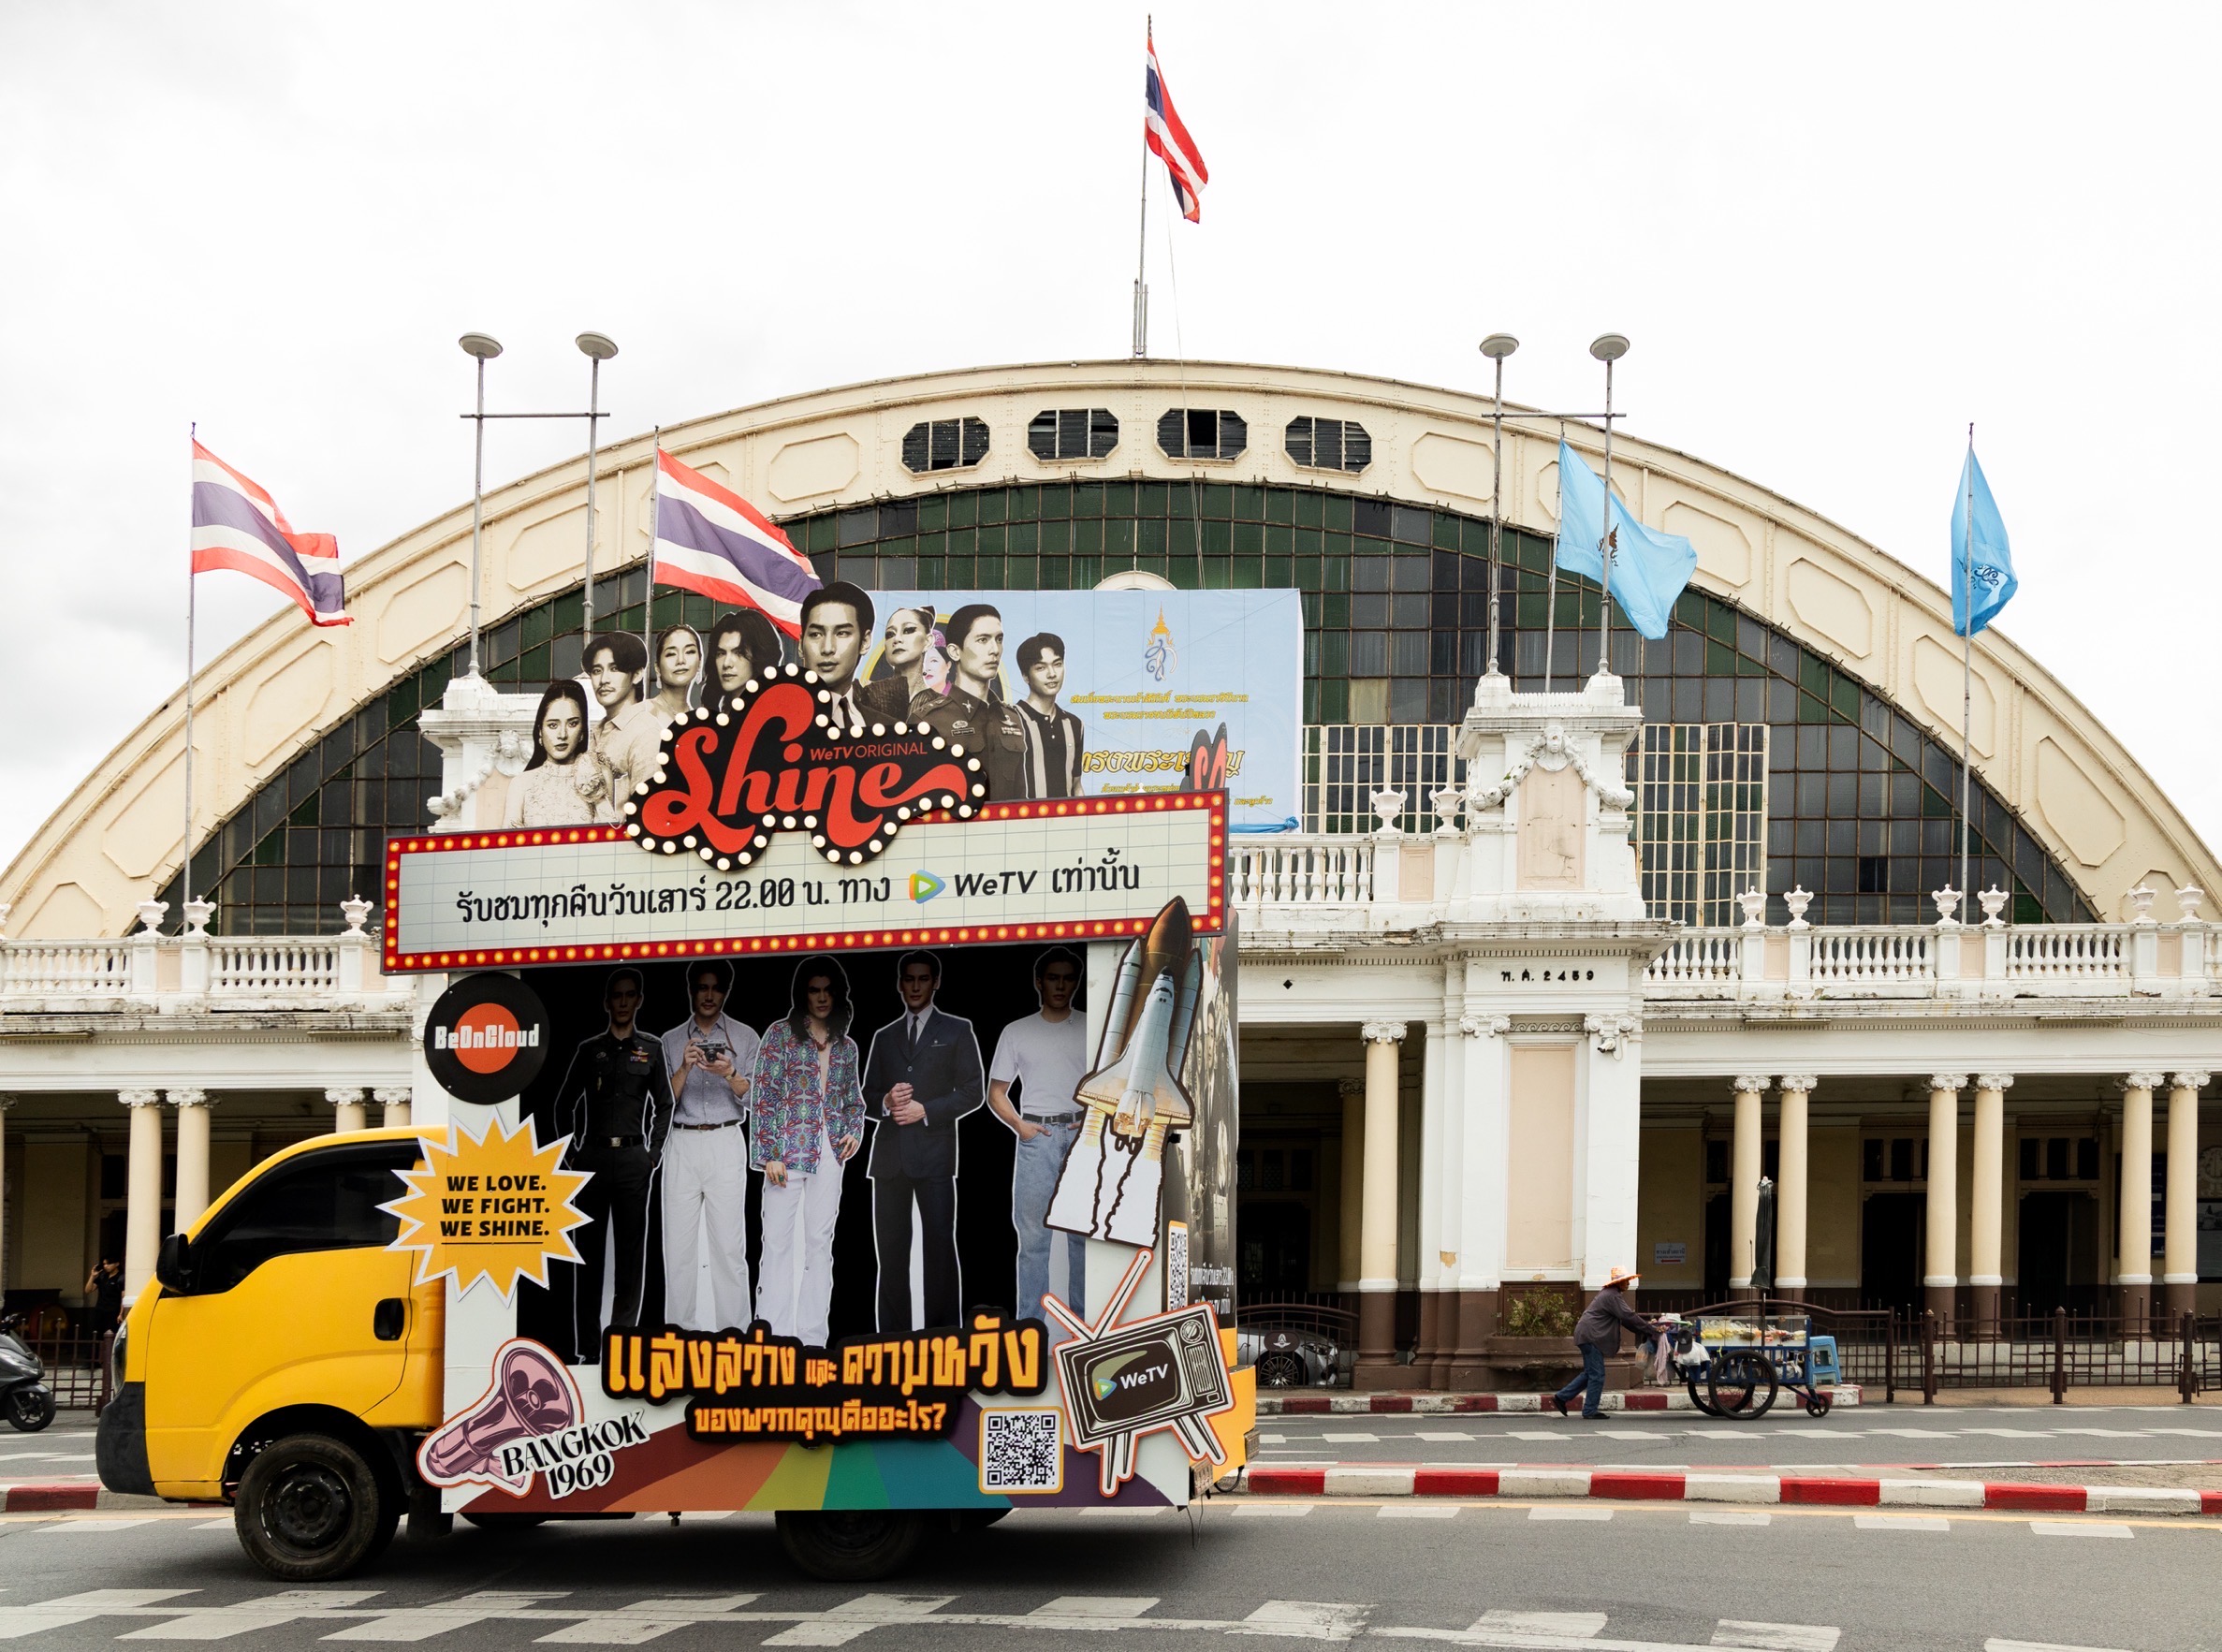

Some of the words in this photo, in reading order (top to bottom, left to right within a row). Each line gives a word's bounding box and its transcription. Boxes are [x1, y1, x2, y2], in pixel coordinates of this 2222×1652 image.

[810, 746, 854, 761] WeTV
[855, 742, 928, 758] ORIGINAL
[642, 683, 967, 854] Shine
[456, 875, 706, 928] รับชมทุกคืนวันเสาร์
[715, 879, 795, 914] 22.00
[802, 882, 829, 905] น.
[839, 875, 891, 903] ทาง
[955, 870, 1038, 897] WeTV
[1052, 848, 1139, 894] เท่านั้น
[1543, 970, 1594, 982] 2459
[434, 1023, 539, 1049] BeOnCloud
[446, 1176, 479, 1191] WE
[486, 1176, 547, 1191] LOVE.
[442, 1198, 474, 1214] WE
[480, 1197, 550, 1214] FIGHT.
[441, 1221, 473, 1236] WE
[478, 1220, 549, 1236] SHINE.
[609, 1329, 796, 1397] แสงสว่าง
[805, 1359, 837, 1387] และ
[842, 1314, 1039, 1396] ความหวัง
[1119, 1363, 1168, 1390] WeTV
[694, 1399, 946, 1440] ของพวกคุณคืออะไร?
[502, 1411, 647, 1477] BANGKOK
[548, 1454, 611, 1496] 1969
